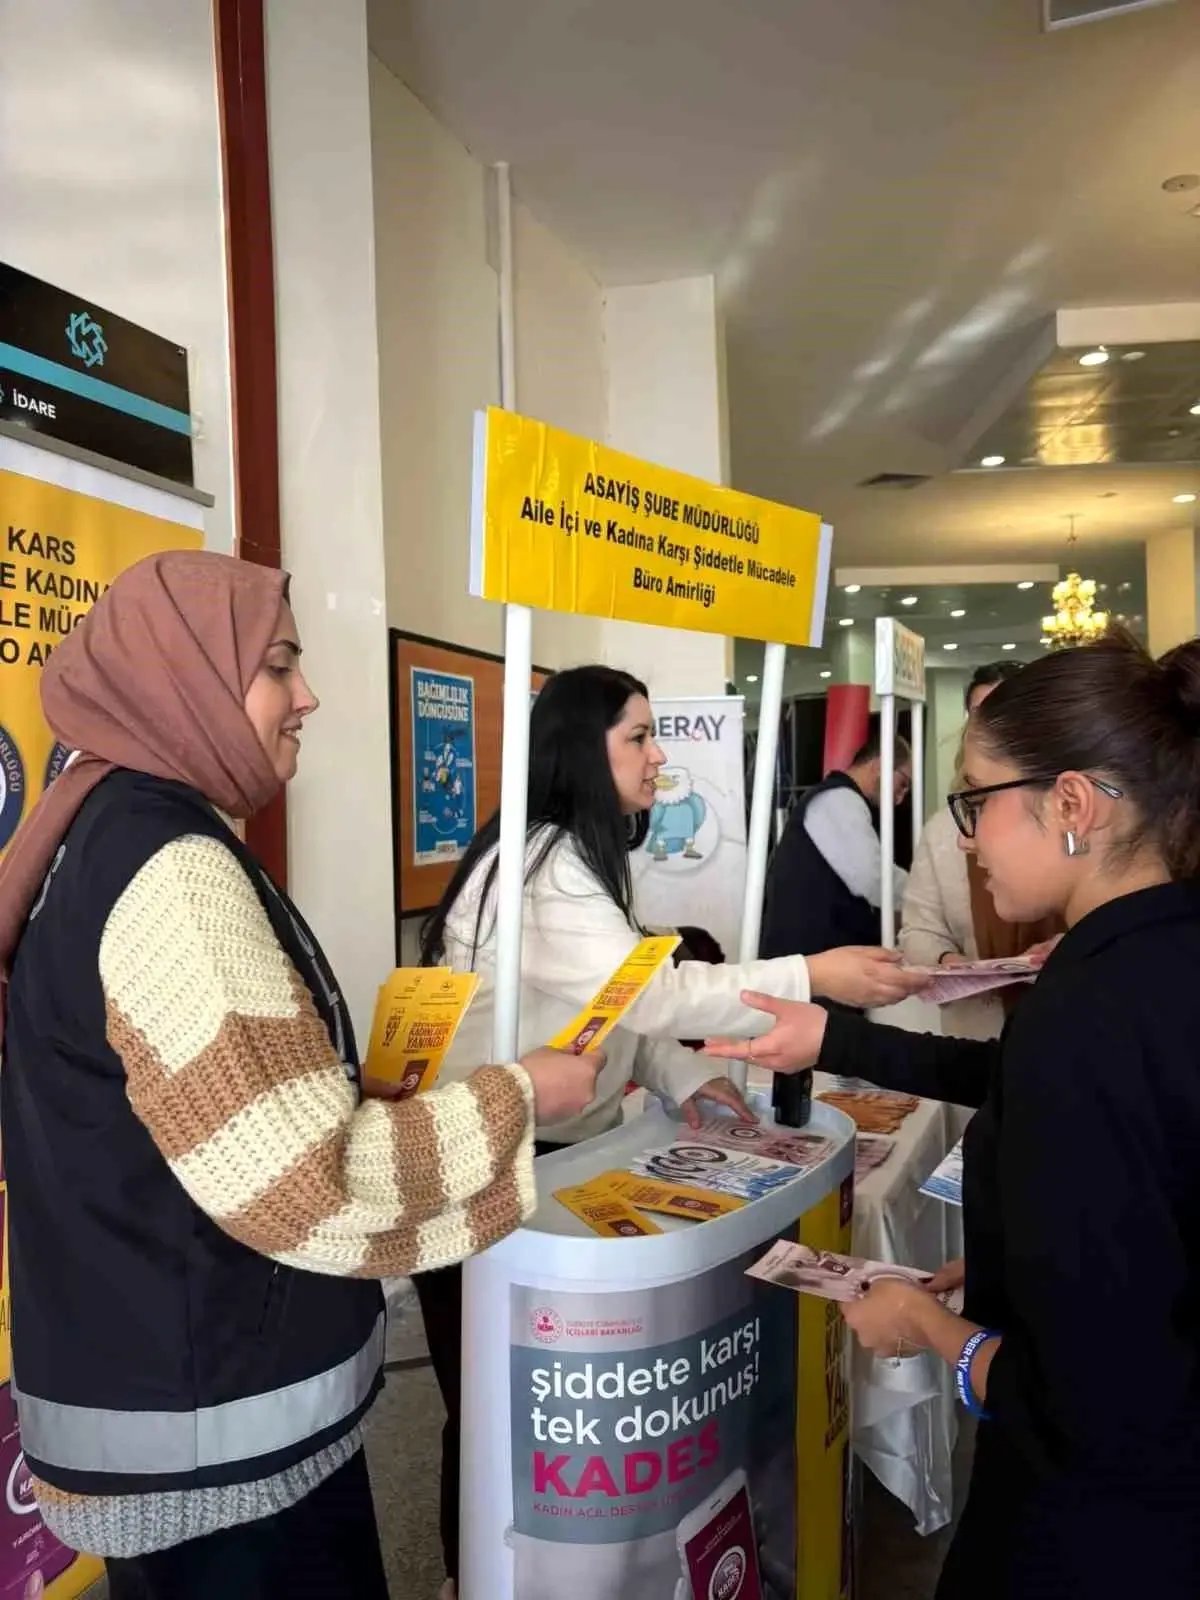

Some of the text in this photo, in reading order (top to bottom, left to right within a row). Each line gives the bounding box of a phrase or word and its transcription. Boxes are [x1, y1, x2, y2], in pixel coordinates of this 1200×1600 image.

[12, 388, 57, 420] İDARE
[521, 496, 797, 588] Aile İçi ve Kadına Karşı Şiddetle Mücadele
[584, 472, 760, 544] ASAYİŞ ŞUBE MÜDÜRLÜĞÜ
[7, 526, 76, 566] KARS
[26, 567, 111, 604] KADIN
[633, 567, 716, 608] Büro Amirliği
[531, 1316, 760, 1403] şiddete karşı
[531, 1407, 601, 1445] tek
[615, 1352, 760, 1443] dokunuş!
[532, 1419, 721, 1499] KADES
